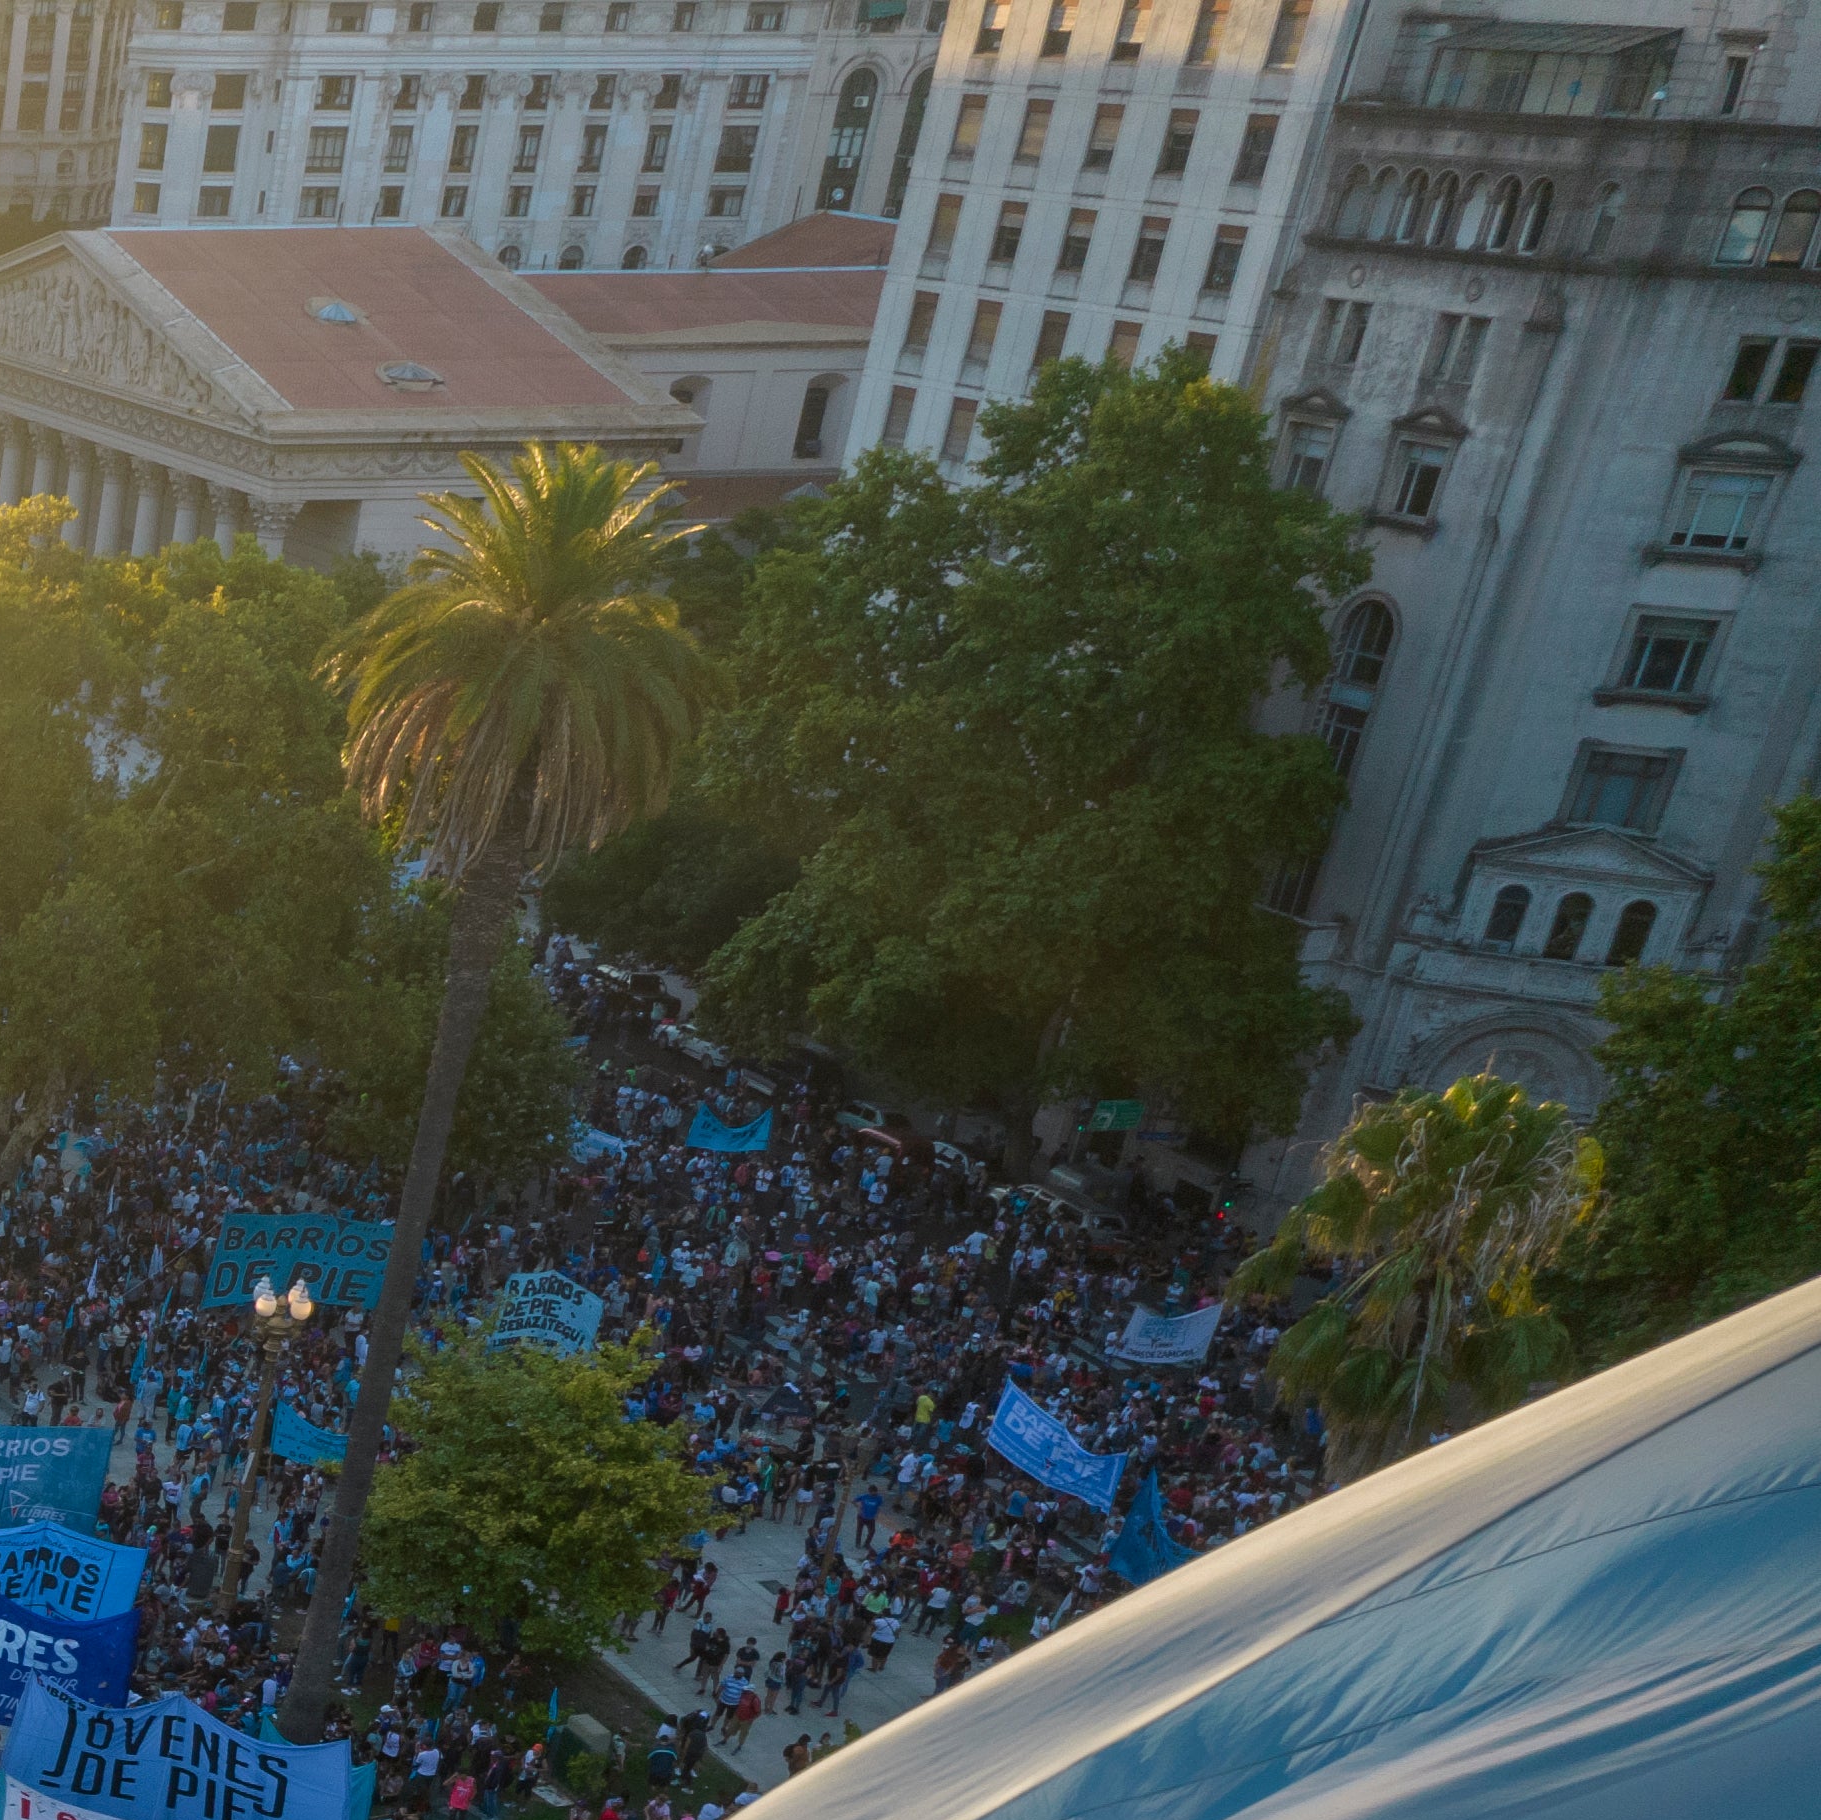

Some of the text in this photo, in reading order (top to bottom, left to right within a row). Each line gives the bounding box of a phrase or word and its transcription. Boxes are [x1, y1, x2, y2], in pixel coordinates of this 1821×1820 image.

[224, 1226, 390, 1262] BARRIOS
[213, 1259, 375, 1302] DE PIE
[509, 1273, 585, 1306] BARRIOS
[502, 1298, 562, 1317] DE PIE
[497, 1317, 586, 1347] BERAZATEGUI
[20, 1504, 67, 1522] LIBRES
[36, 1574, 98, 1614] PIE
[71, 1752, 136, 1800] DE
